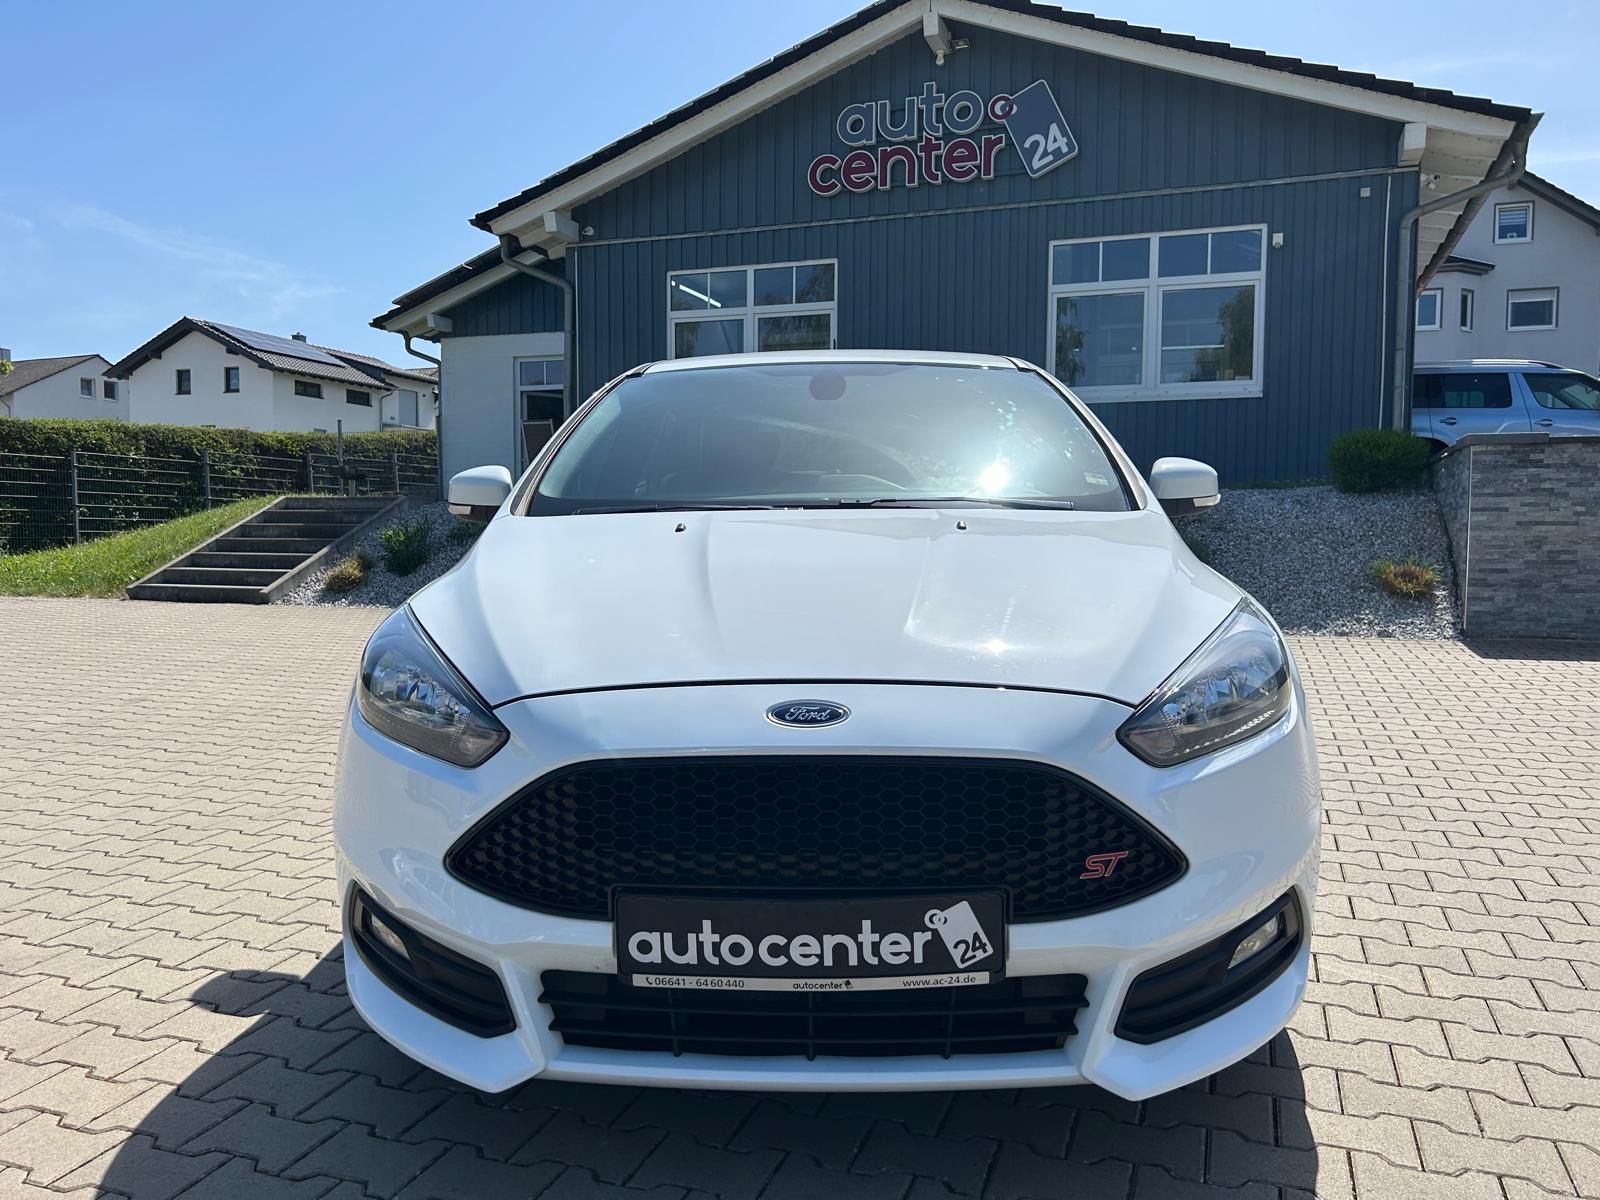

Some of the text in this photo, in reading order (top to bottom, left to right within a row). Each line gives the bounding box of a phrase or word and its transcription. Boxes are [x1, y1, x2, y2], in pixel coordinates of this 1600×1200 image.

[837, 82, 984, 145] auto
[1023, 122, 1069, 170] 24
[808, 132, 1005, 196] center
[785, 706, 831, 720] Ford
[1080, 851, 1129, 879] ST
[953, 931, 988, 965] 24
[654, 977, 686, 986] 06641
[792, 982, 843, 990] autocenter
[902, 975, 976, 987] www.ac-24.de
